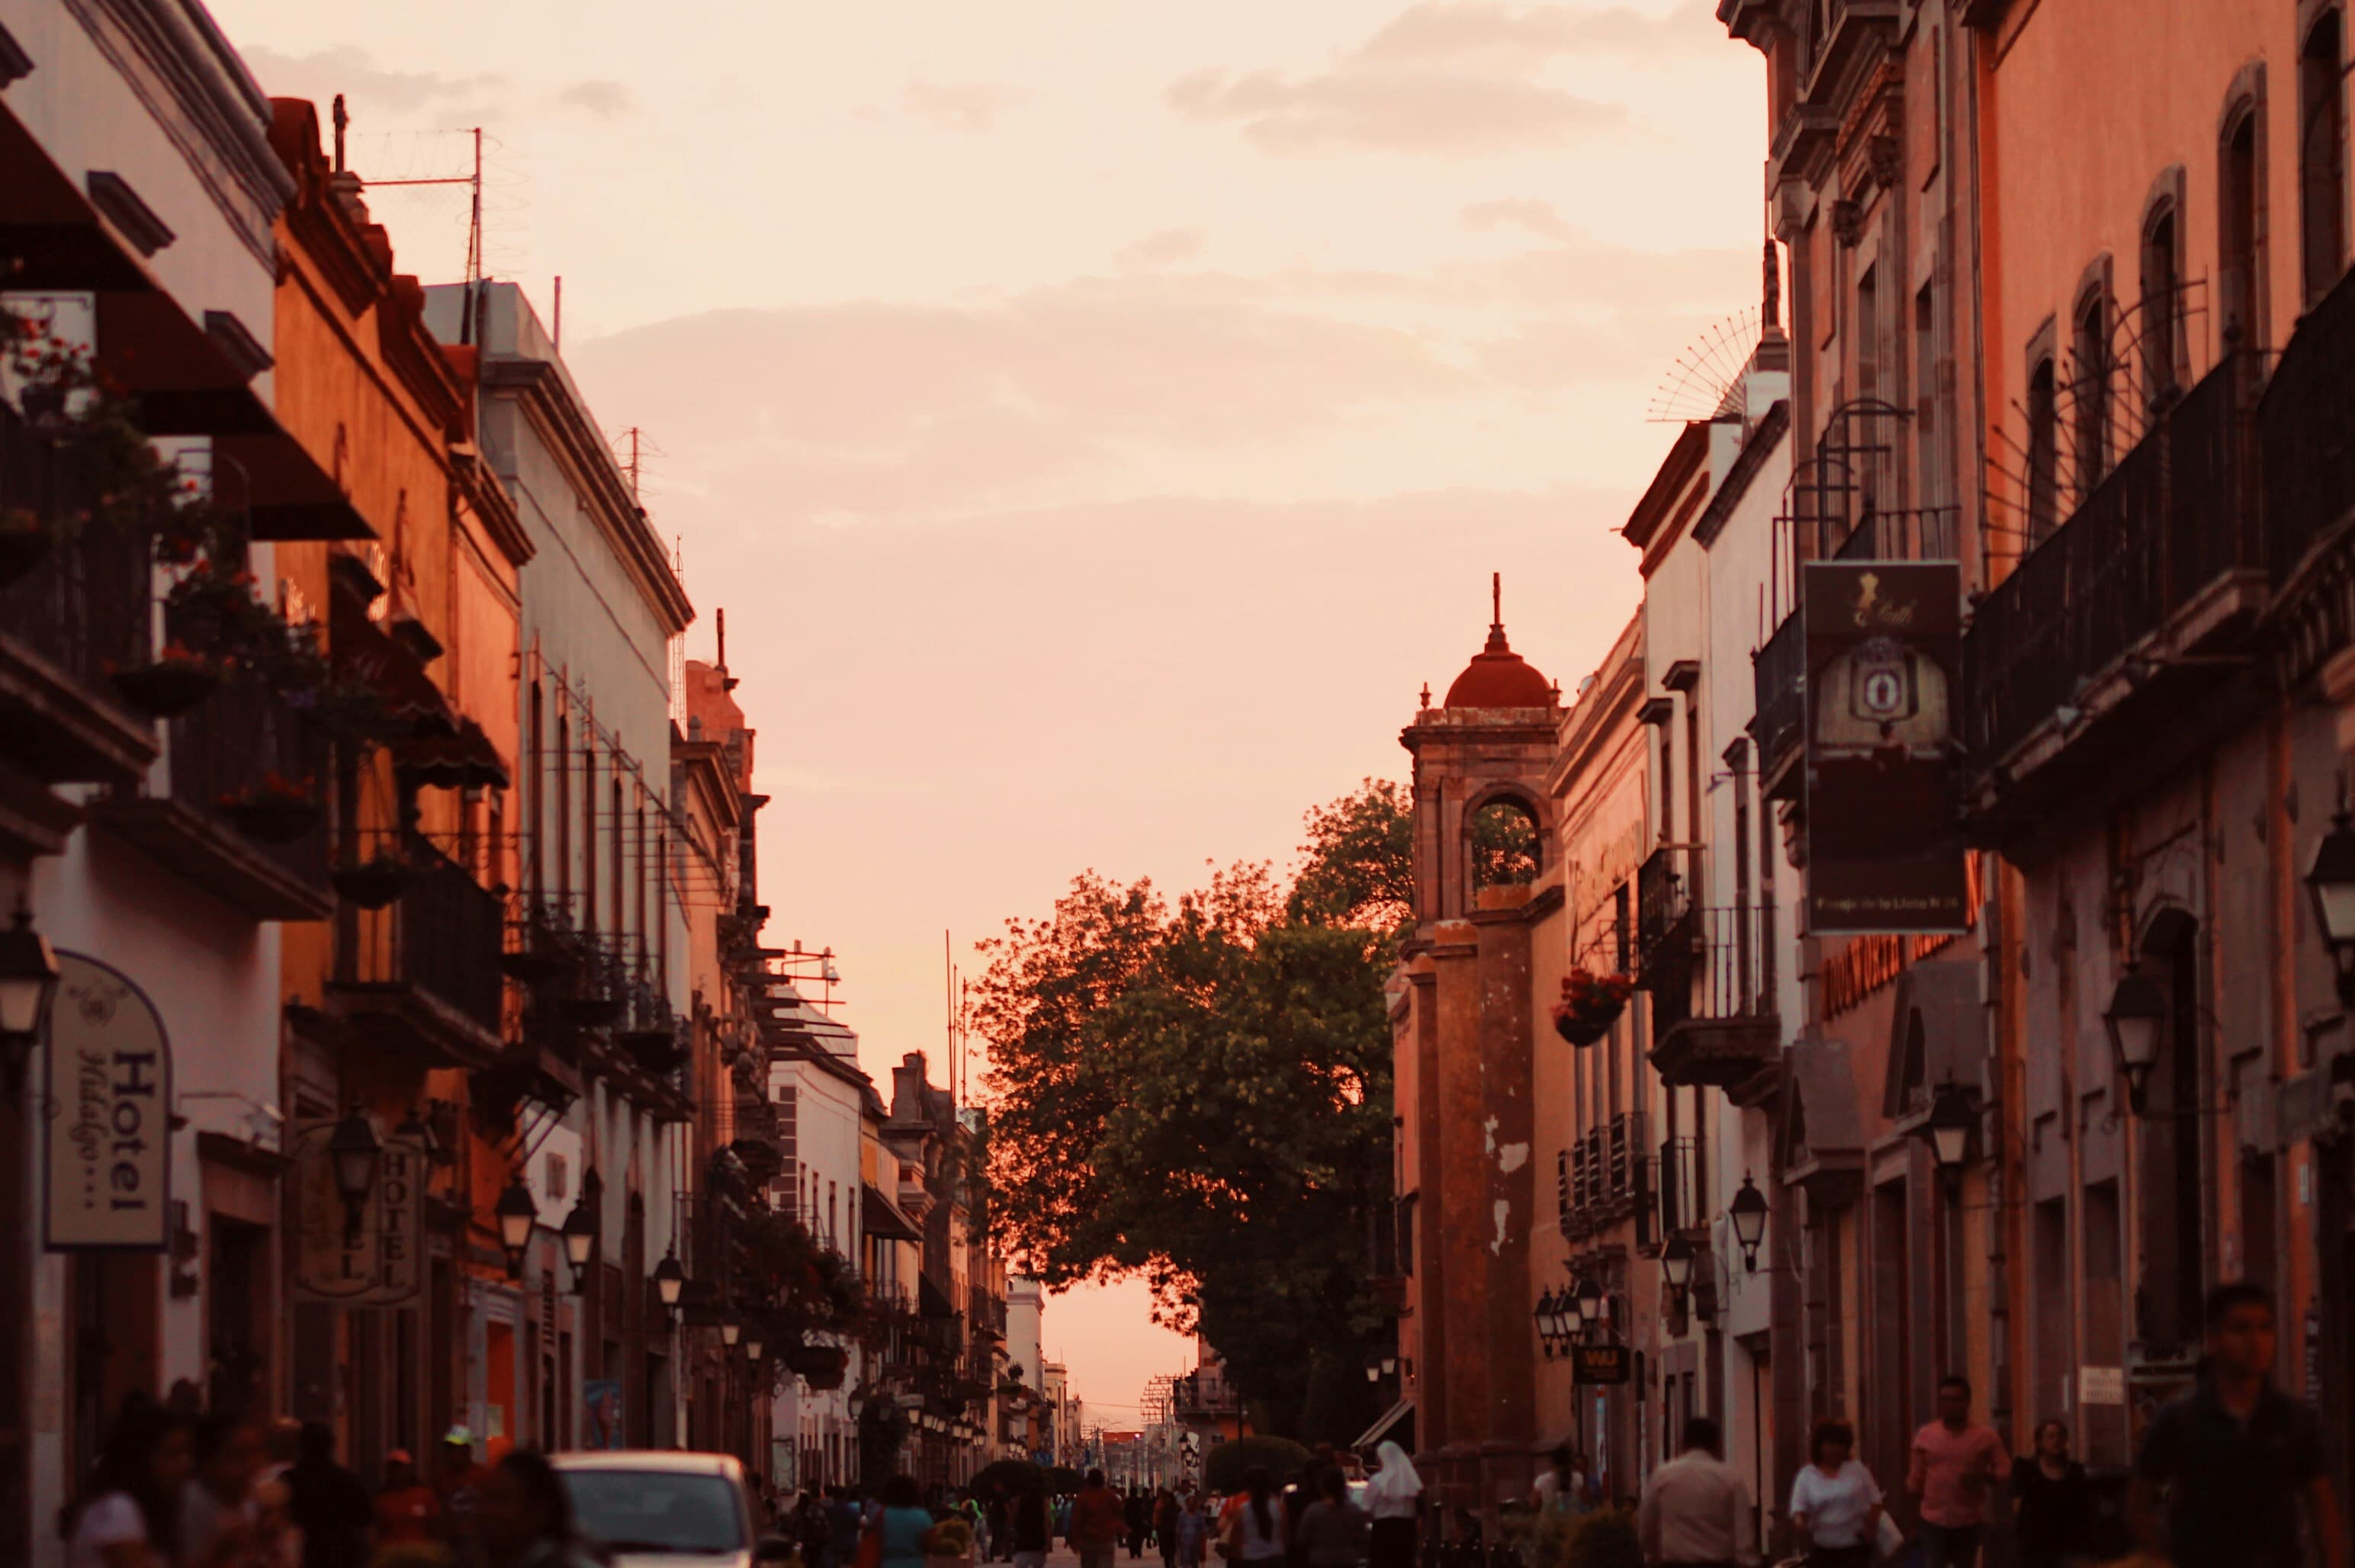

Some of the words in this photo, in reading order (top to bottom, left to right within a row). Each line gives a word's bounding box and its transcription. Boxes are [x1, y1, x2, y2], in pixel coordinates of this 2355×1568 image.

[69, 1050, 110, 1162] Hidalgo
[111, 1051, 156, 1210] Hotel
[383, 1152, 409, 1288] HOTEL
